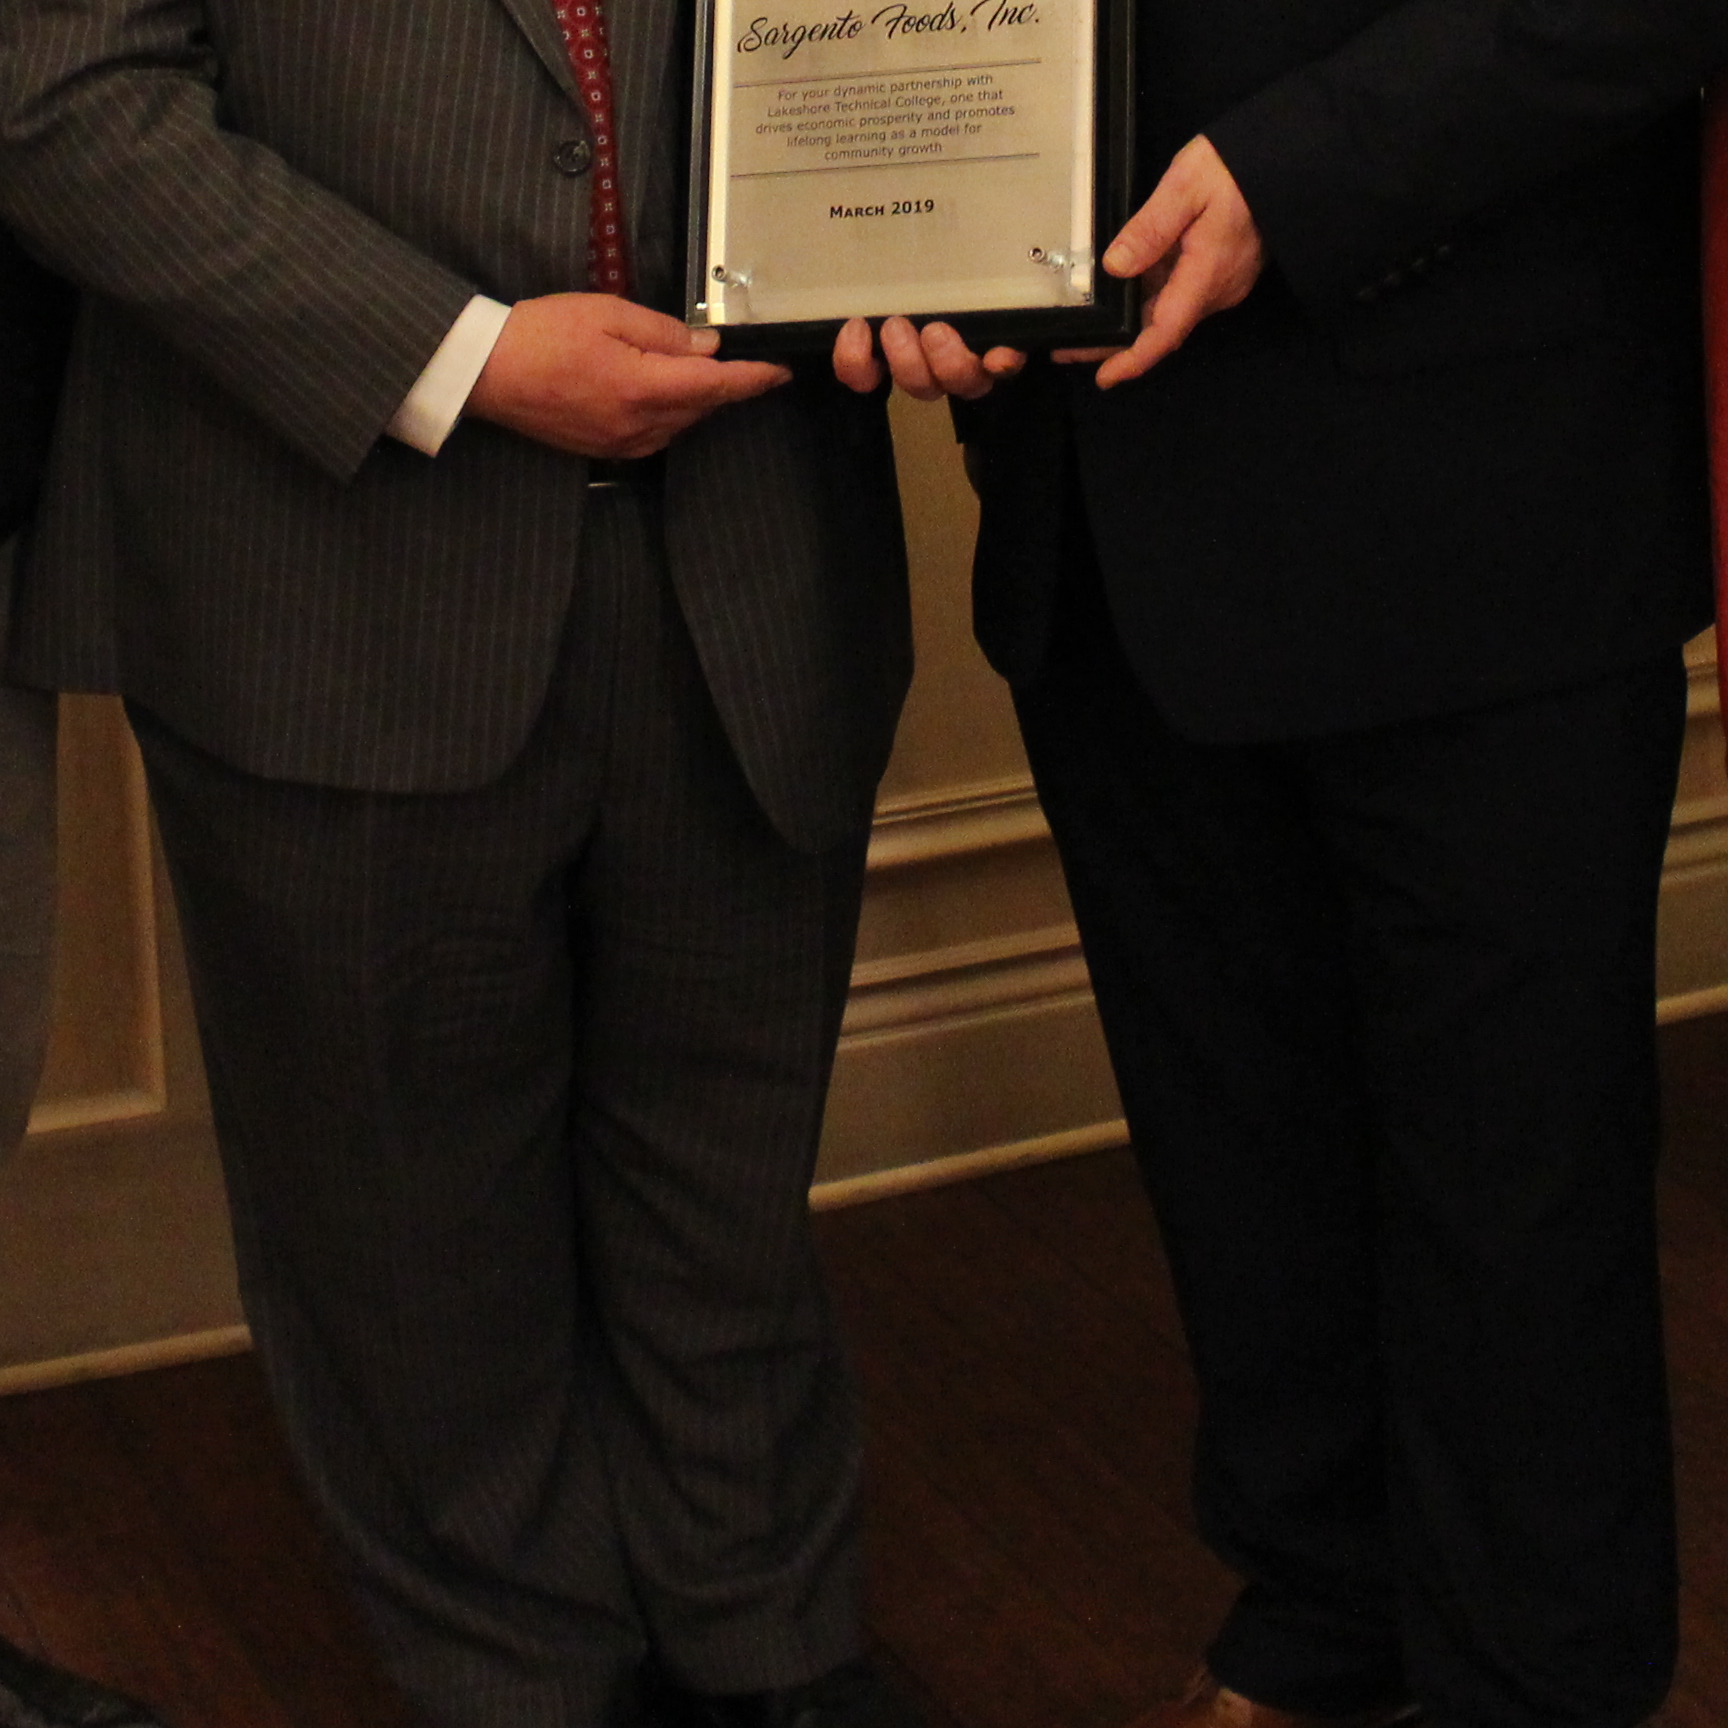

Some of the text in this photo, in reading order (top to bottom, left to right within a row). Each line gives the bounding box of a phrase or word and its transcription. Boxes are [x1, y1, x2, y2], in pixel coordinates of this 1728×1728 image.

[737, 10, 866, 60] Sargento
[871, 1, 968, 39] Foods,
[778, 75, 993, 101] For your dynamic partnership with
[767, 89, 1003, 118] Lakeshore Technical College, one that
[755, 105, 1015, 134] drives economic prosperity and promotes
[787, 123, 982, 148] lifelong learning as a model for
[824, 142, 942, 161] community growth
[829, 199, 934, 219] MARCH 2019
